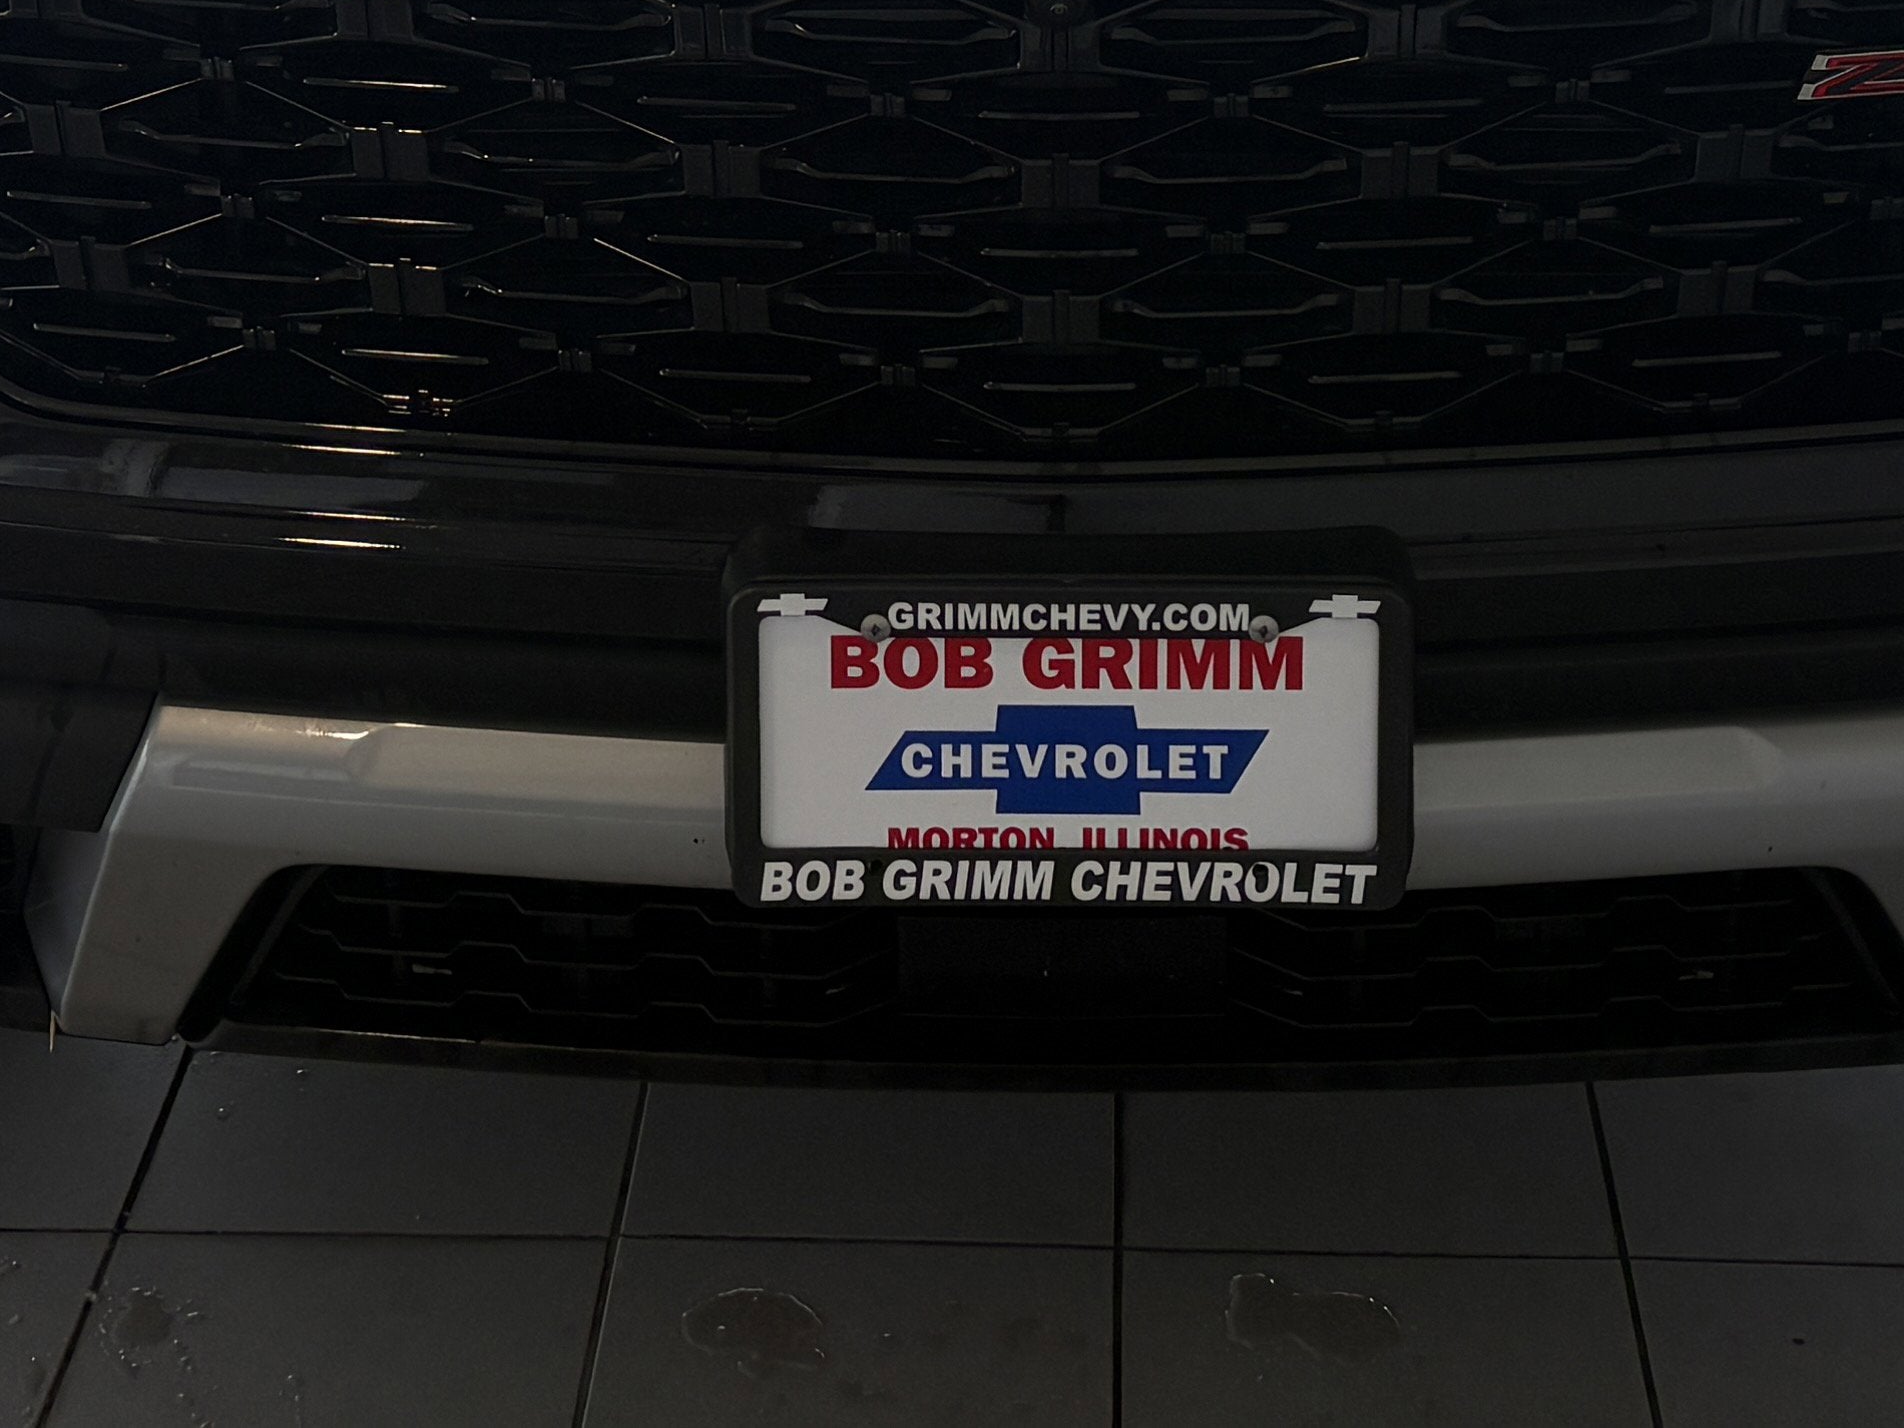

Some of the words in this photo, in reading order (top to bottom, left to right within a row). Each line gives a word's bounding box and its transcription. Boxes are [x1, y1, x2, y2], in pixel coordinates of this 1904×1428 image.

[887, 601, 1250, 632] GRIMMCHEVY.COM
[829, 636, 994, 690] BOB
[1021, 636, 1305, 691] GRIMM
[900, 741, 1230, 781] CHEVROLET
[759, 859, 865, 902] BOB
[882, 858, 1057, 902] GRIMM
[1070, 859, 1378, 906] CHEVROLET
